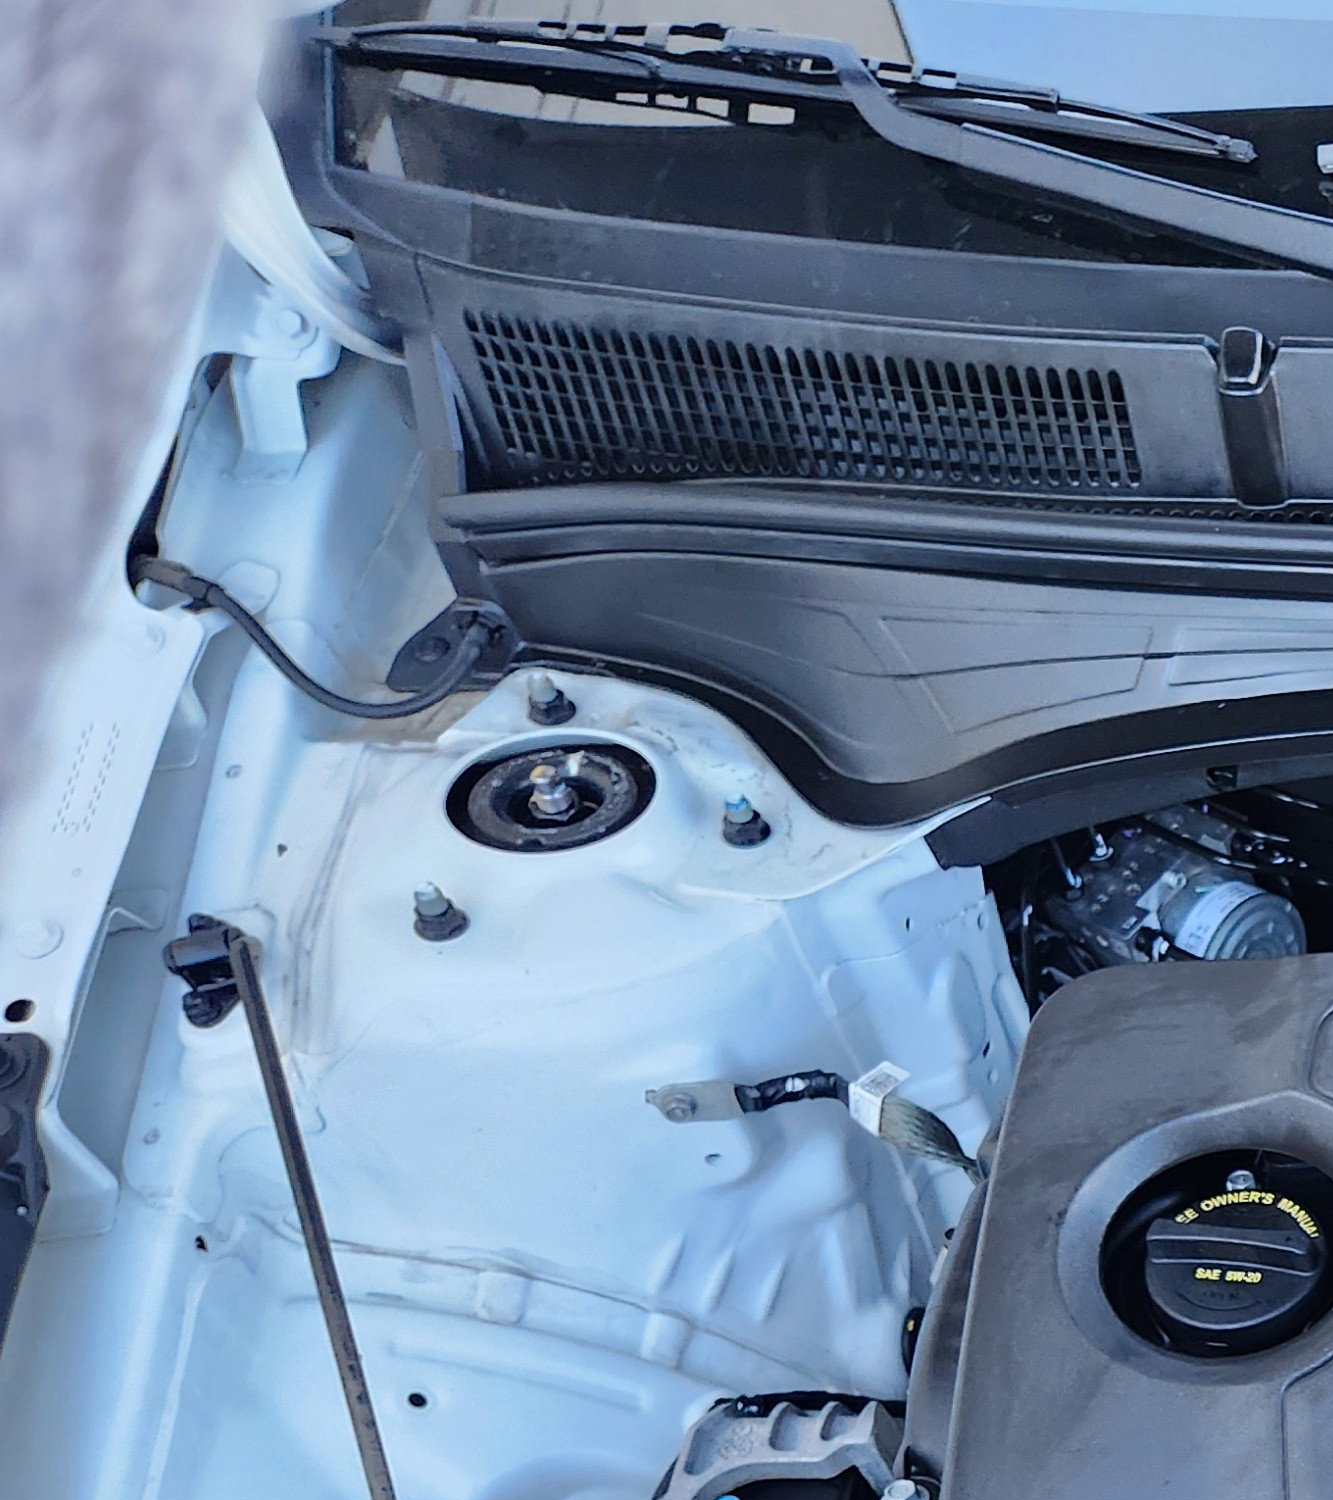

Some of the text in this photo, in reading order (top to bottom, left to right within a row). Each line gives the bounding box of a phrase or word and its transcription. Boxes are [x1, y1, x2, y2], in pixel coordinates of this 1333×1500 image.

[1174, 1208, 1199, 1224] EE
[1200, 1191, 1275, 1211] OWNER'S
[1195, 1268, 1222, 1280] SAE
